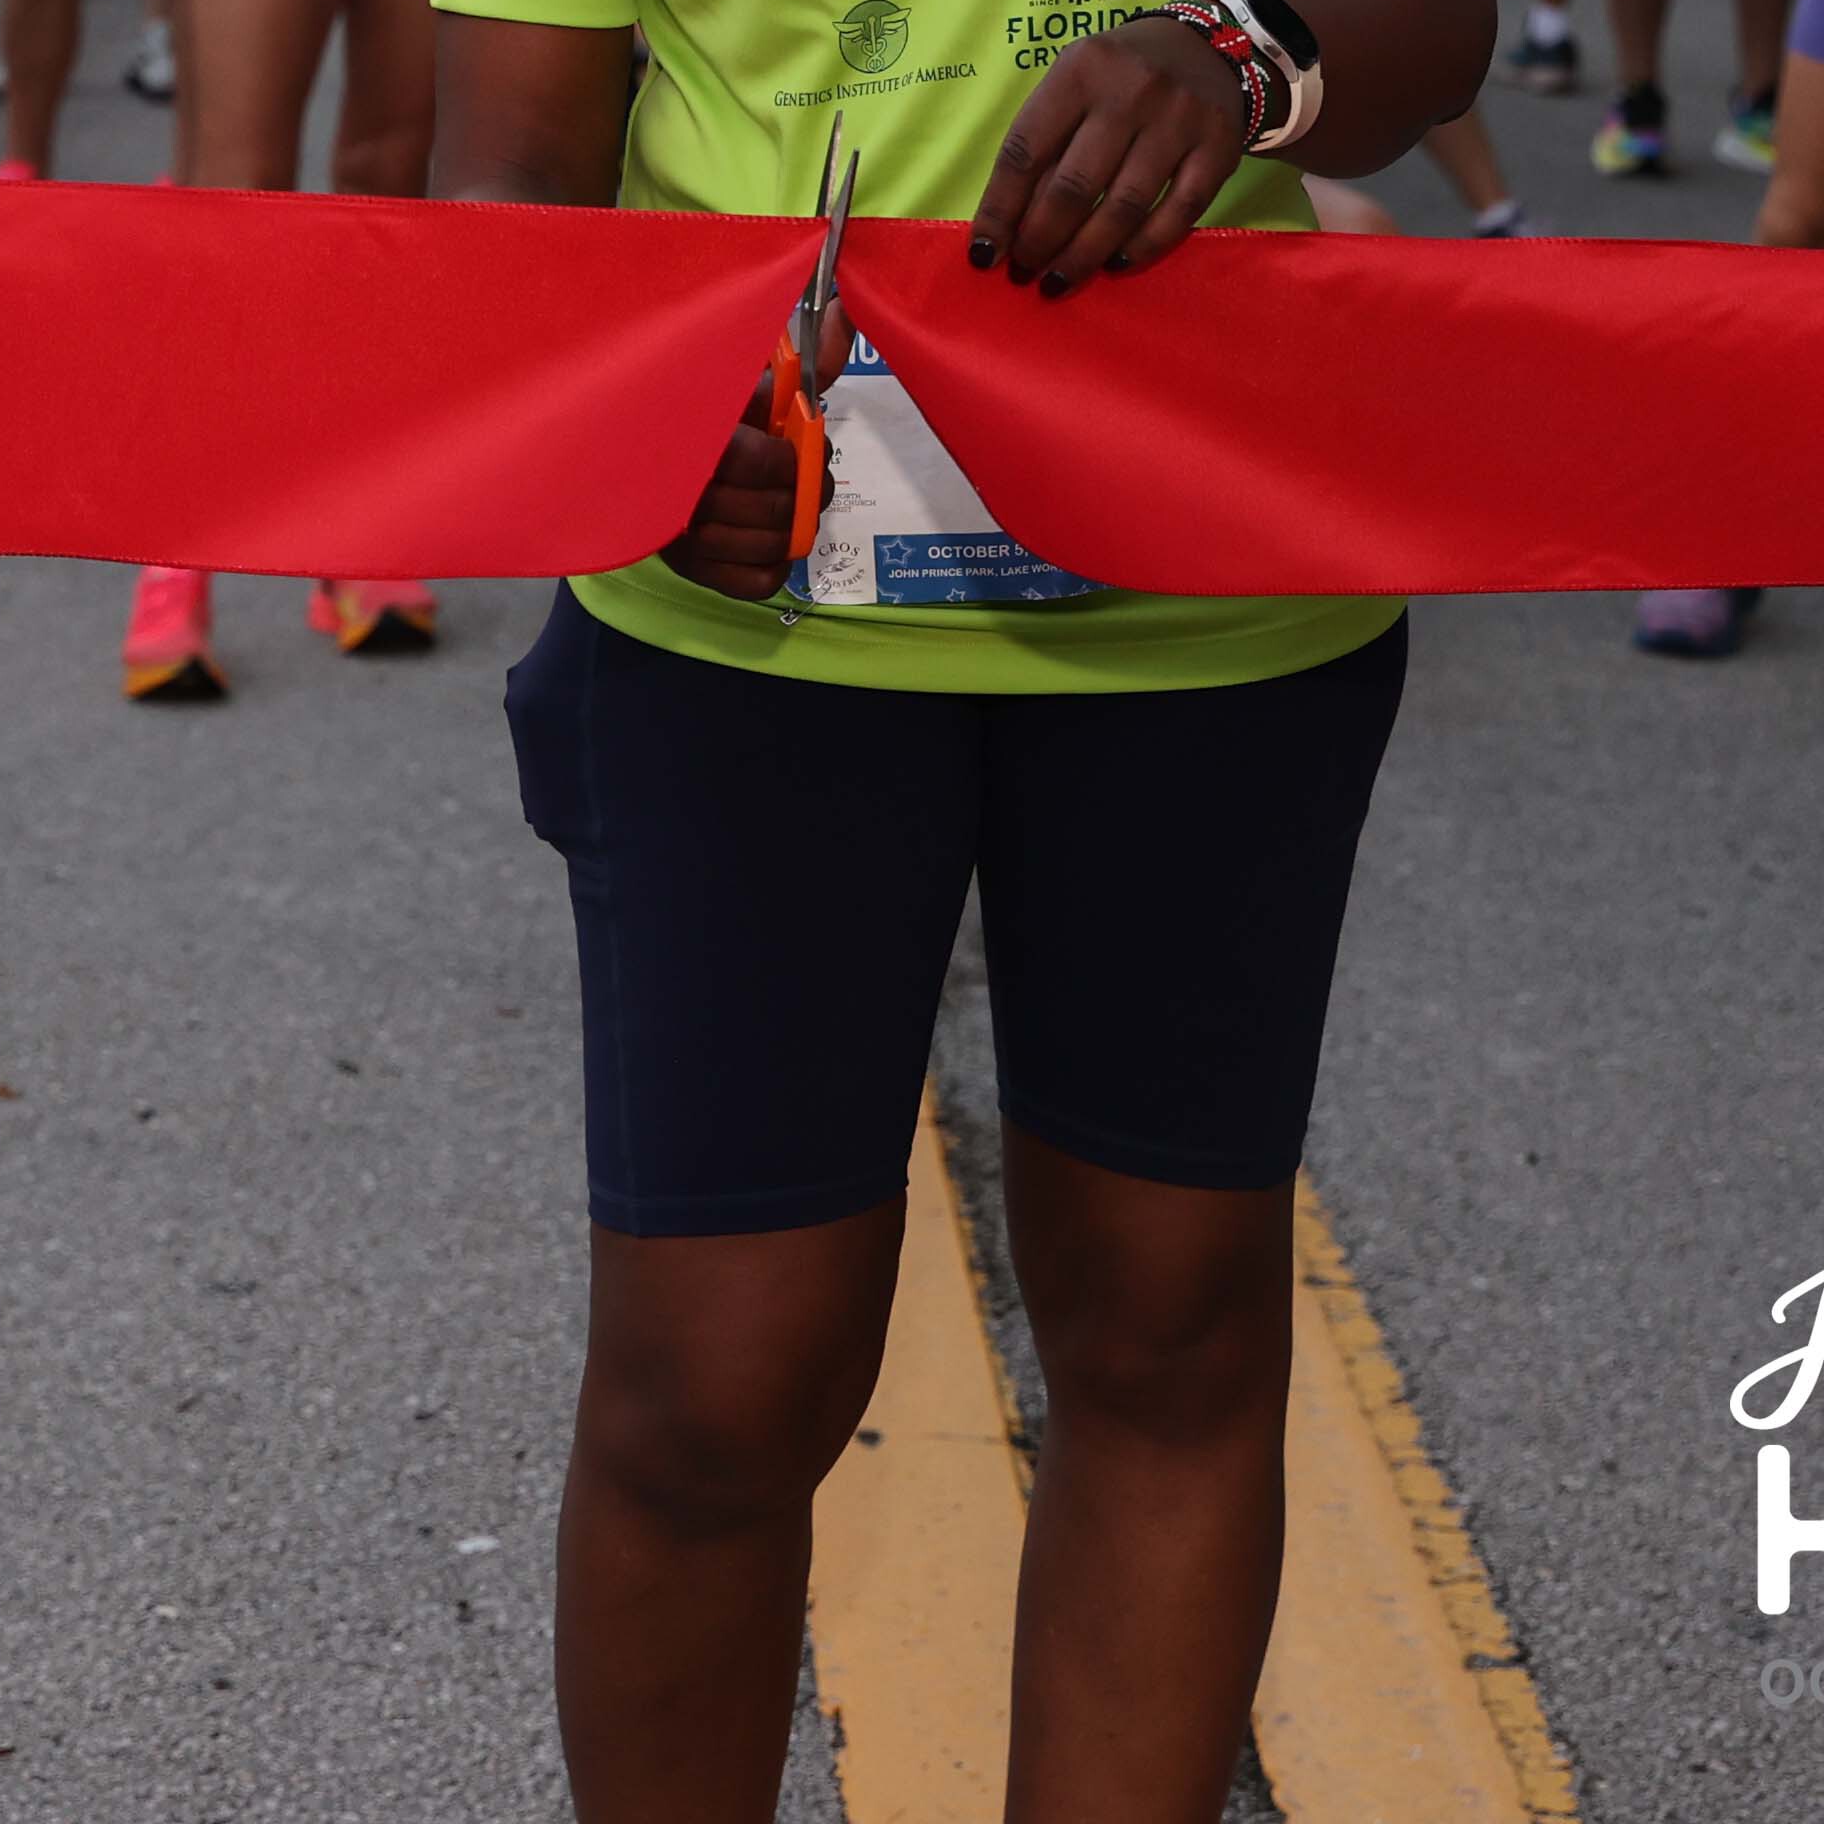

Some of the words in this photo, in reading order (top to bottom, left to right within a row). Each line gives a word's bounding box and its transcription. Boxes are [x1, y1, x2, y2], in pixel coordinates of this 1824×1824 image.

[1029, 0, 1060, 7] SINCE
[774, 88, 832, 107] GENETICS
[837, 78, 900, 100] INSTITUTE
[915, 63, 976, 83] AMERICA
[818, 542, 860, 557] CROS
[928, 544, 1010, 560] OCTOBER
[888, 567, 919, 579] JOHN
[922, 567, 963, 578] PRINCE
[965, 567, 998, 577] PARK,
[1001, 565, 1029, 576] LAKE
